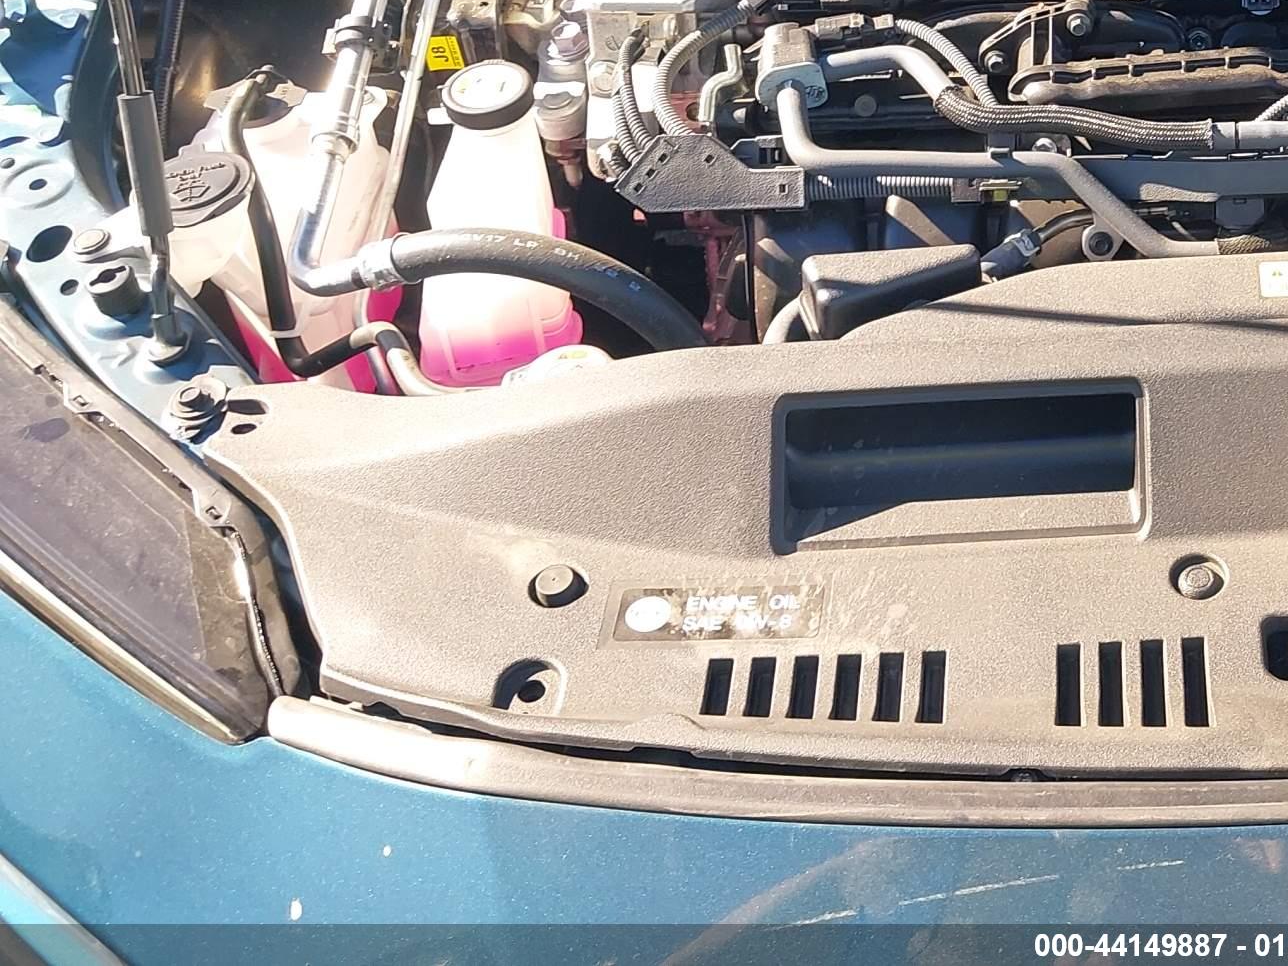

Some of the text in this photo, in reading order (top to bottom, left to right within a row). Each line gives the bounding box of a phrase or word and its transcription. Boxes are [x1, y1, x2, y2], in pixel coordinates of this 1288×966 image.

[431, 45, 449, 62] J8
[685, 594, 801, 612] ENGINE OIL
[682, 616, 725, 632] SAE
